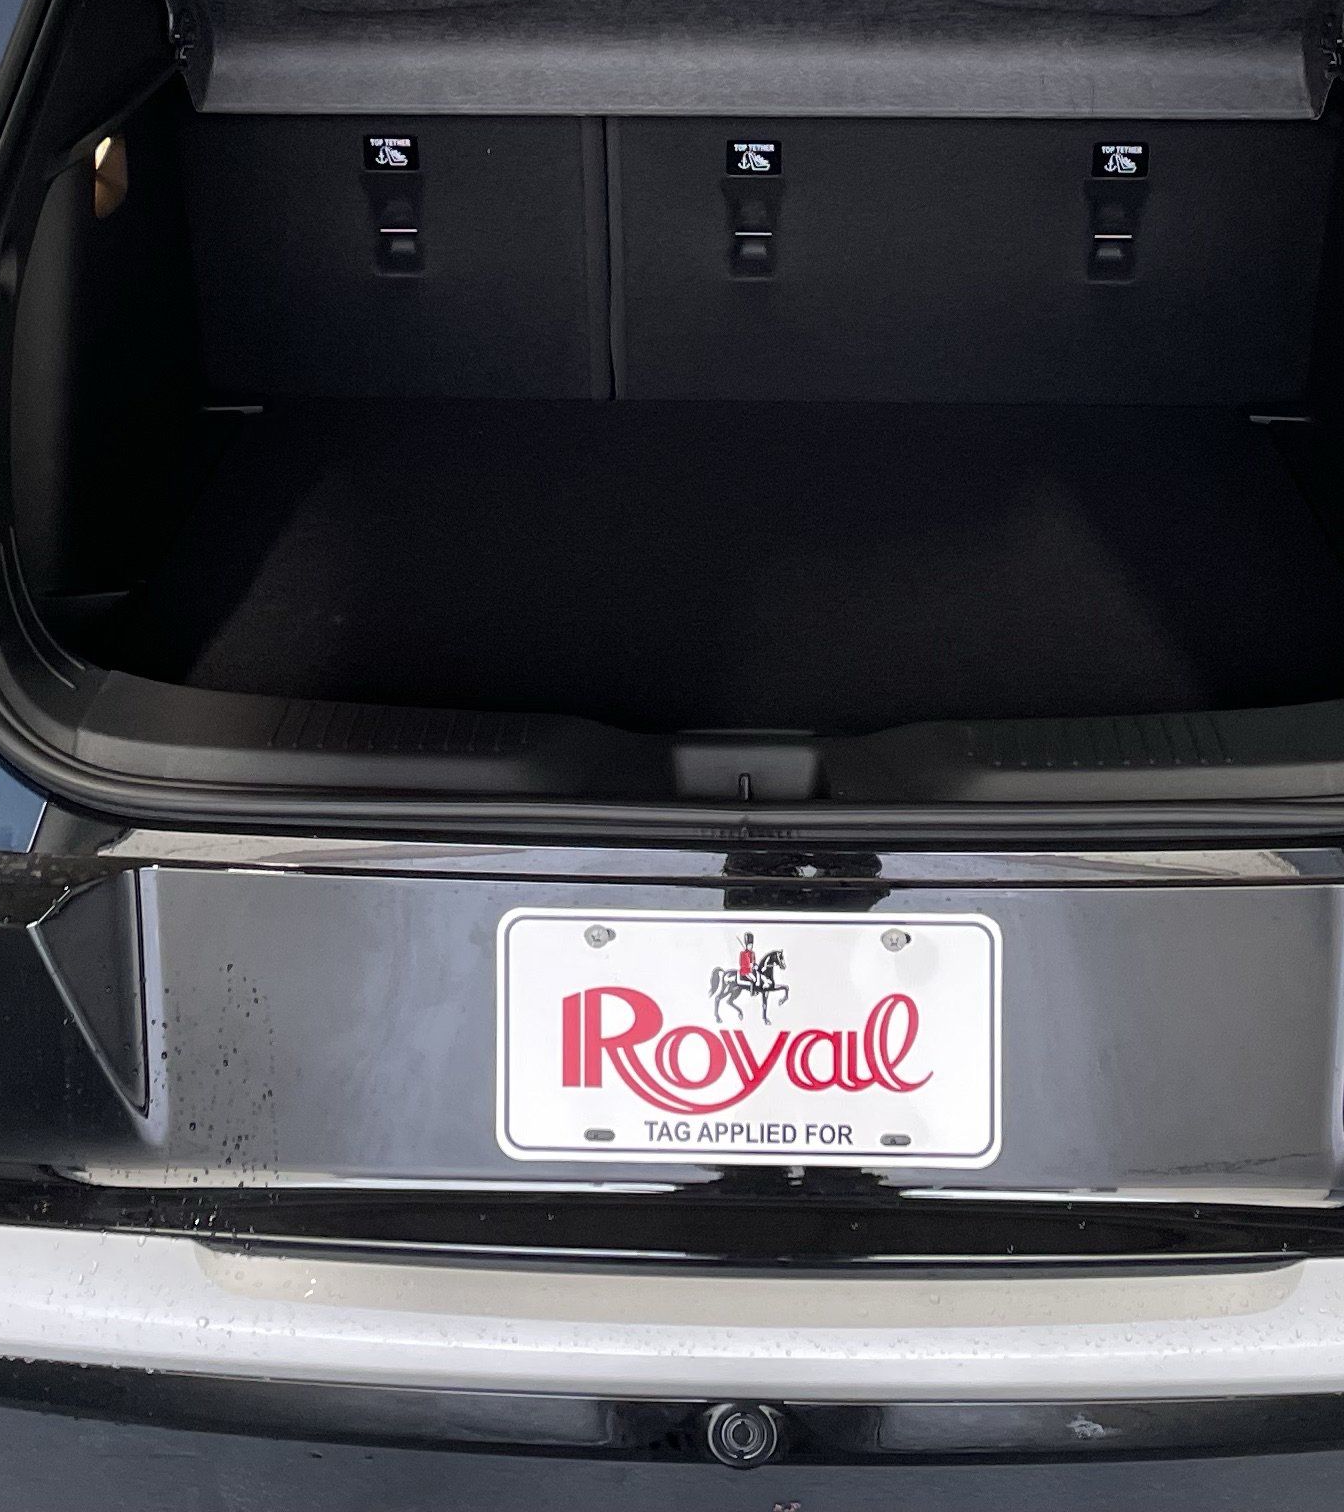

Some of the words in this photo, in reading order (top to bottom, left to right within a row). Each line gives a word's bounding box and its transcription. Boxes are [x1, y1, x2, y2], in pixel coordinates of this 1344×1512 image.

[562, 986, 934, 1115] Royal
[644, 1120, 690, 1142] TAG
[697, 1122, 797, 1144] APPLIED
[805, 1124, 854, 1145] FOR
